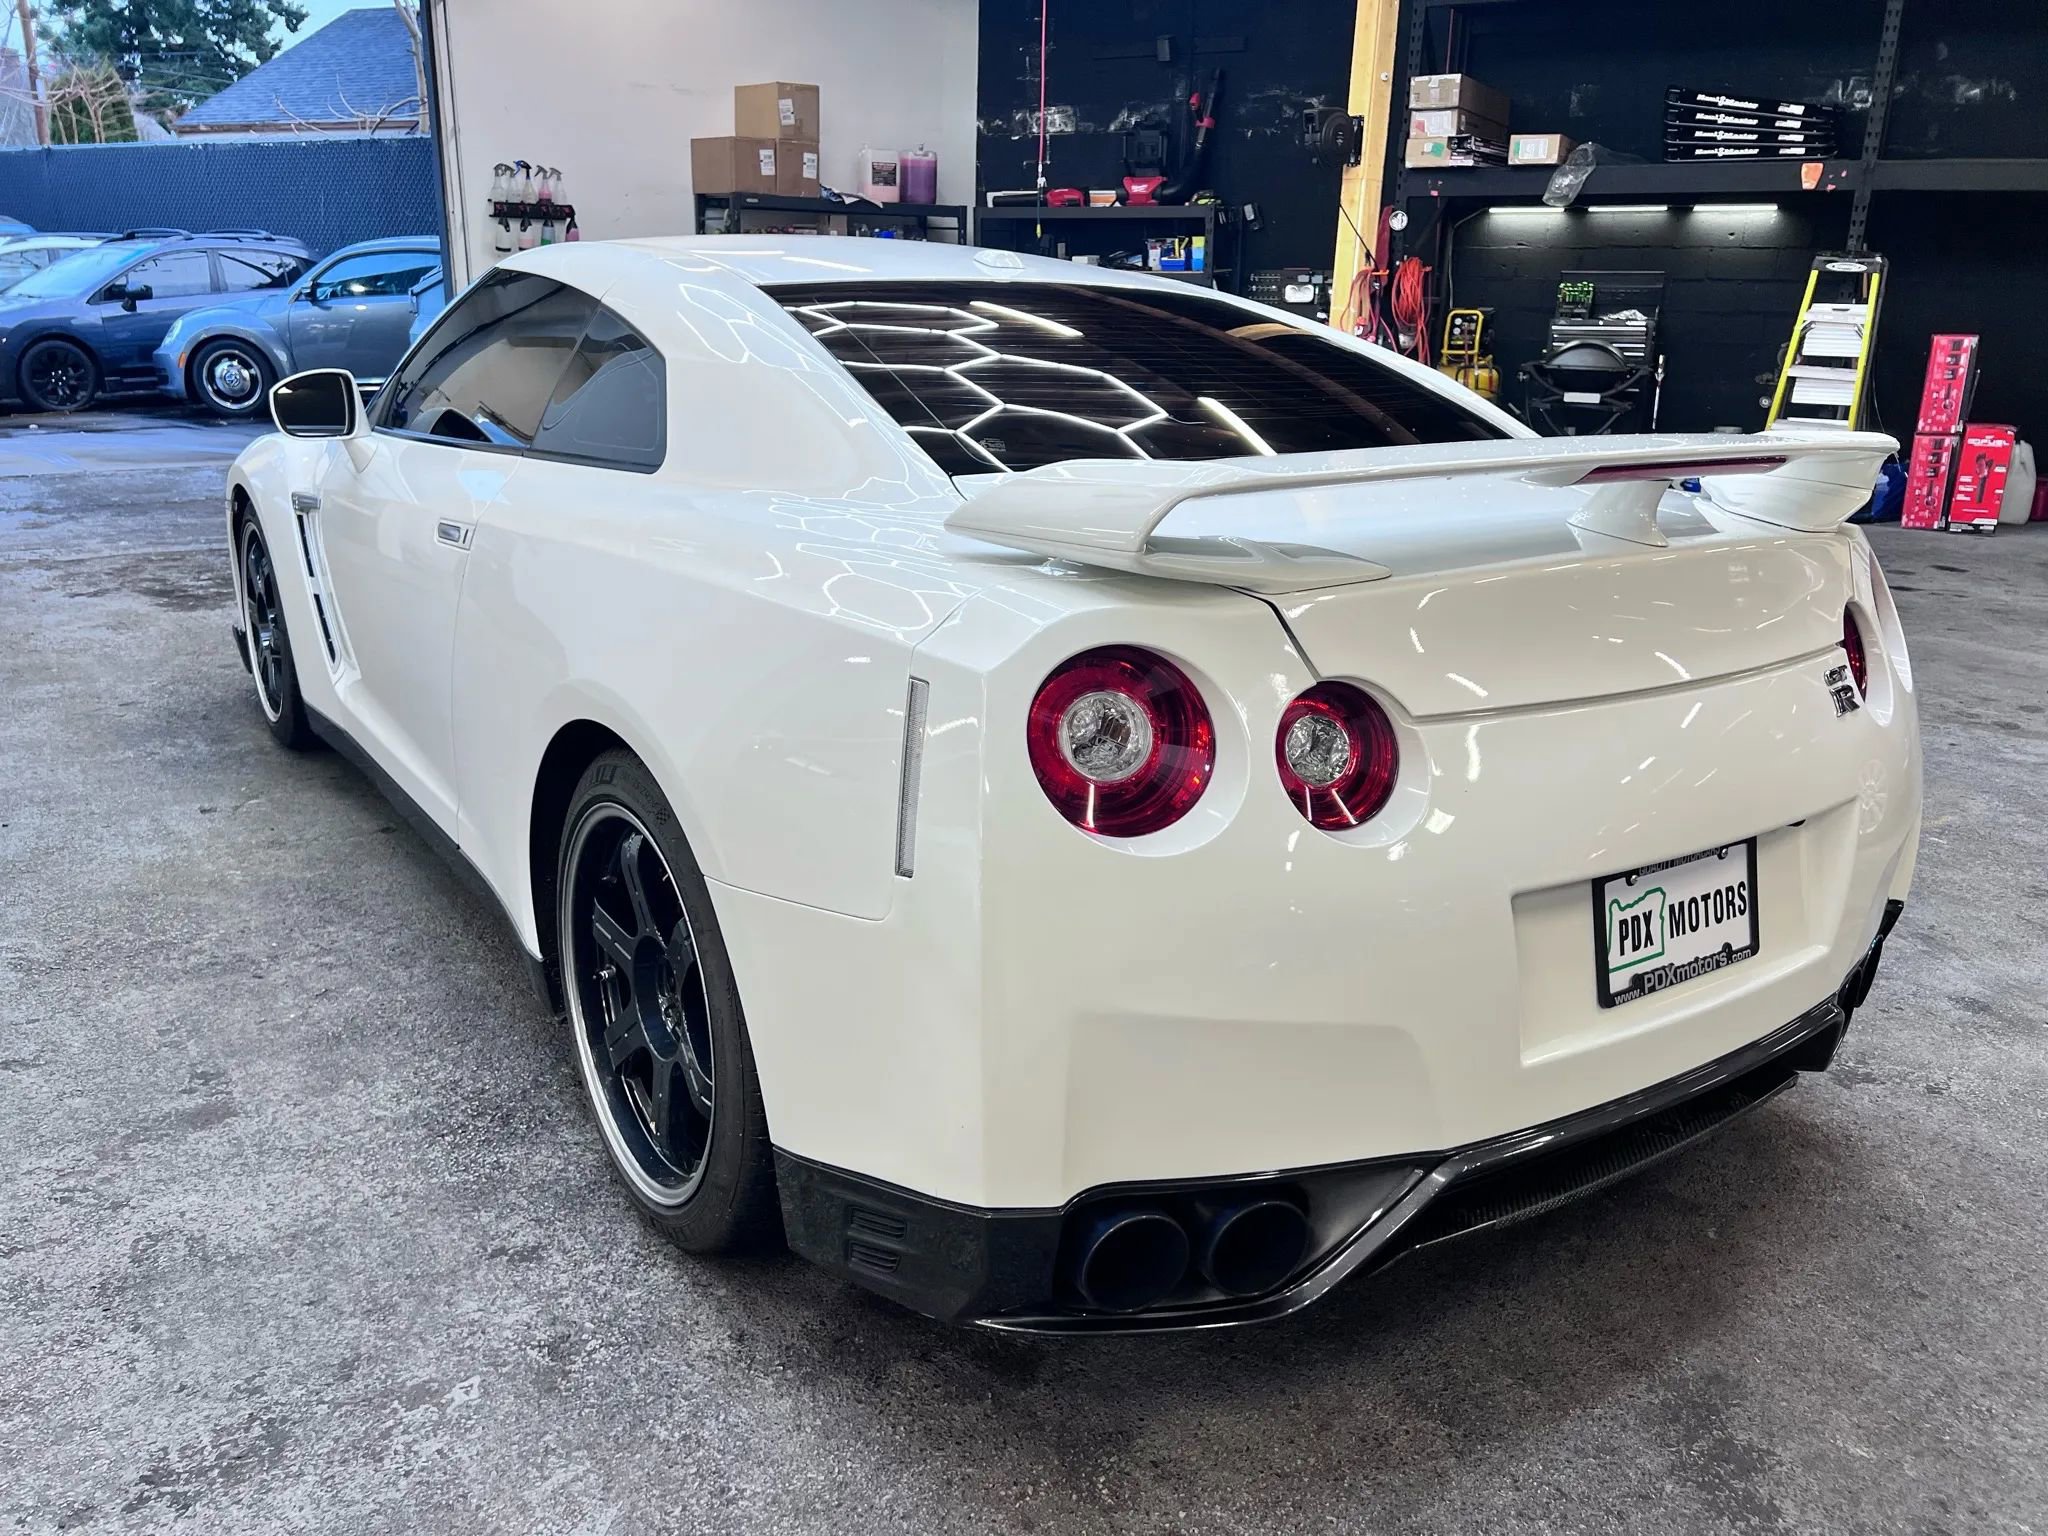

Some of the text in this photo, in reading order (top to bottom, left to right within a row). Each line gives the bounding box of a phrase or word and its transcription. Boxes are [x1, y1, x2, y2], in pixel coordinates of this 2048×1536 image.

[1618, 881, 1748, 957] PDX MOTORS
[1614, 948, 1753, 1006] www.PDXmotors.com
